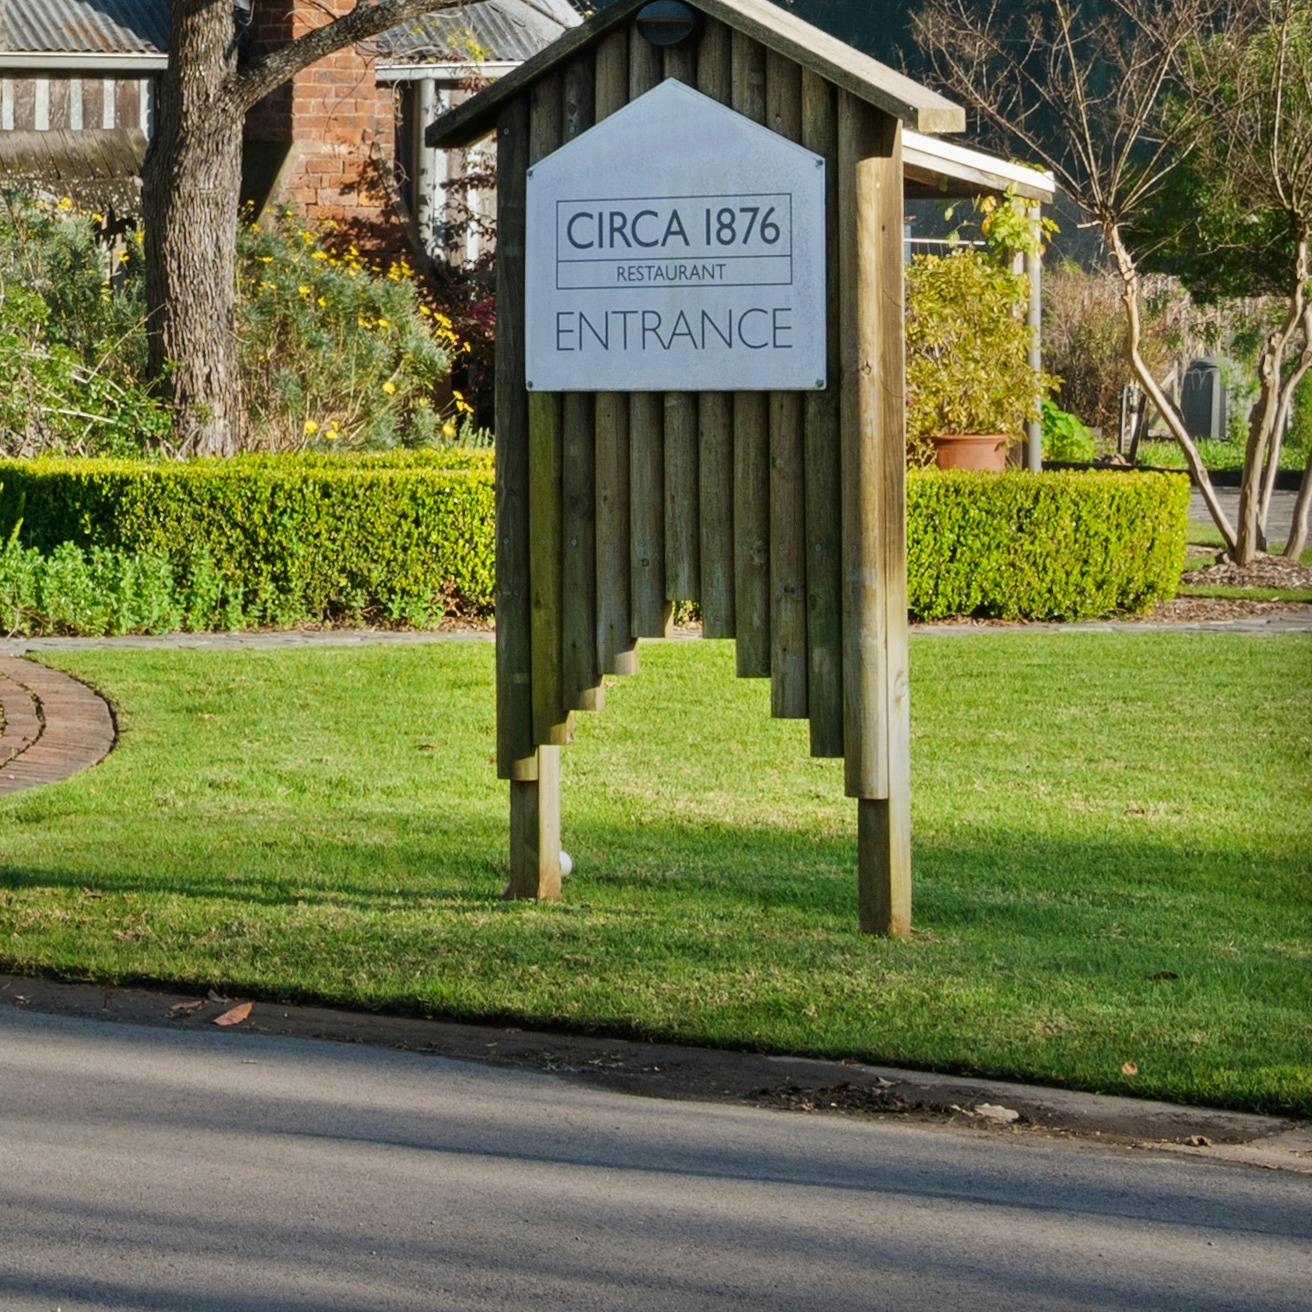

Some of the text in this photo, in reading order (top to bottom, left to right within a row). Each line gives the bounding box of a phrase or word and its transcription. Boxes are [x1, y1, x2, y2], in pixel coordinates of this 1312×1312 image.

[566, 206, 781, 250] CIRCA 1876
[616, 263, 726, 282] RESTAURANT
[556, 308, 793, 352] ENTRANCE
